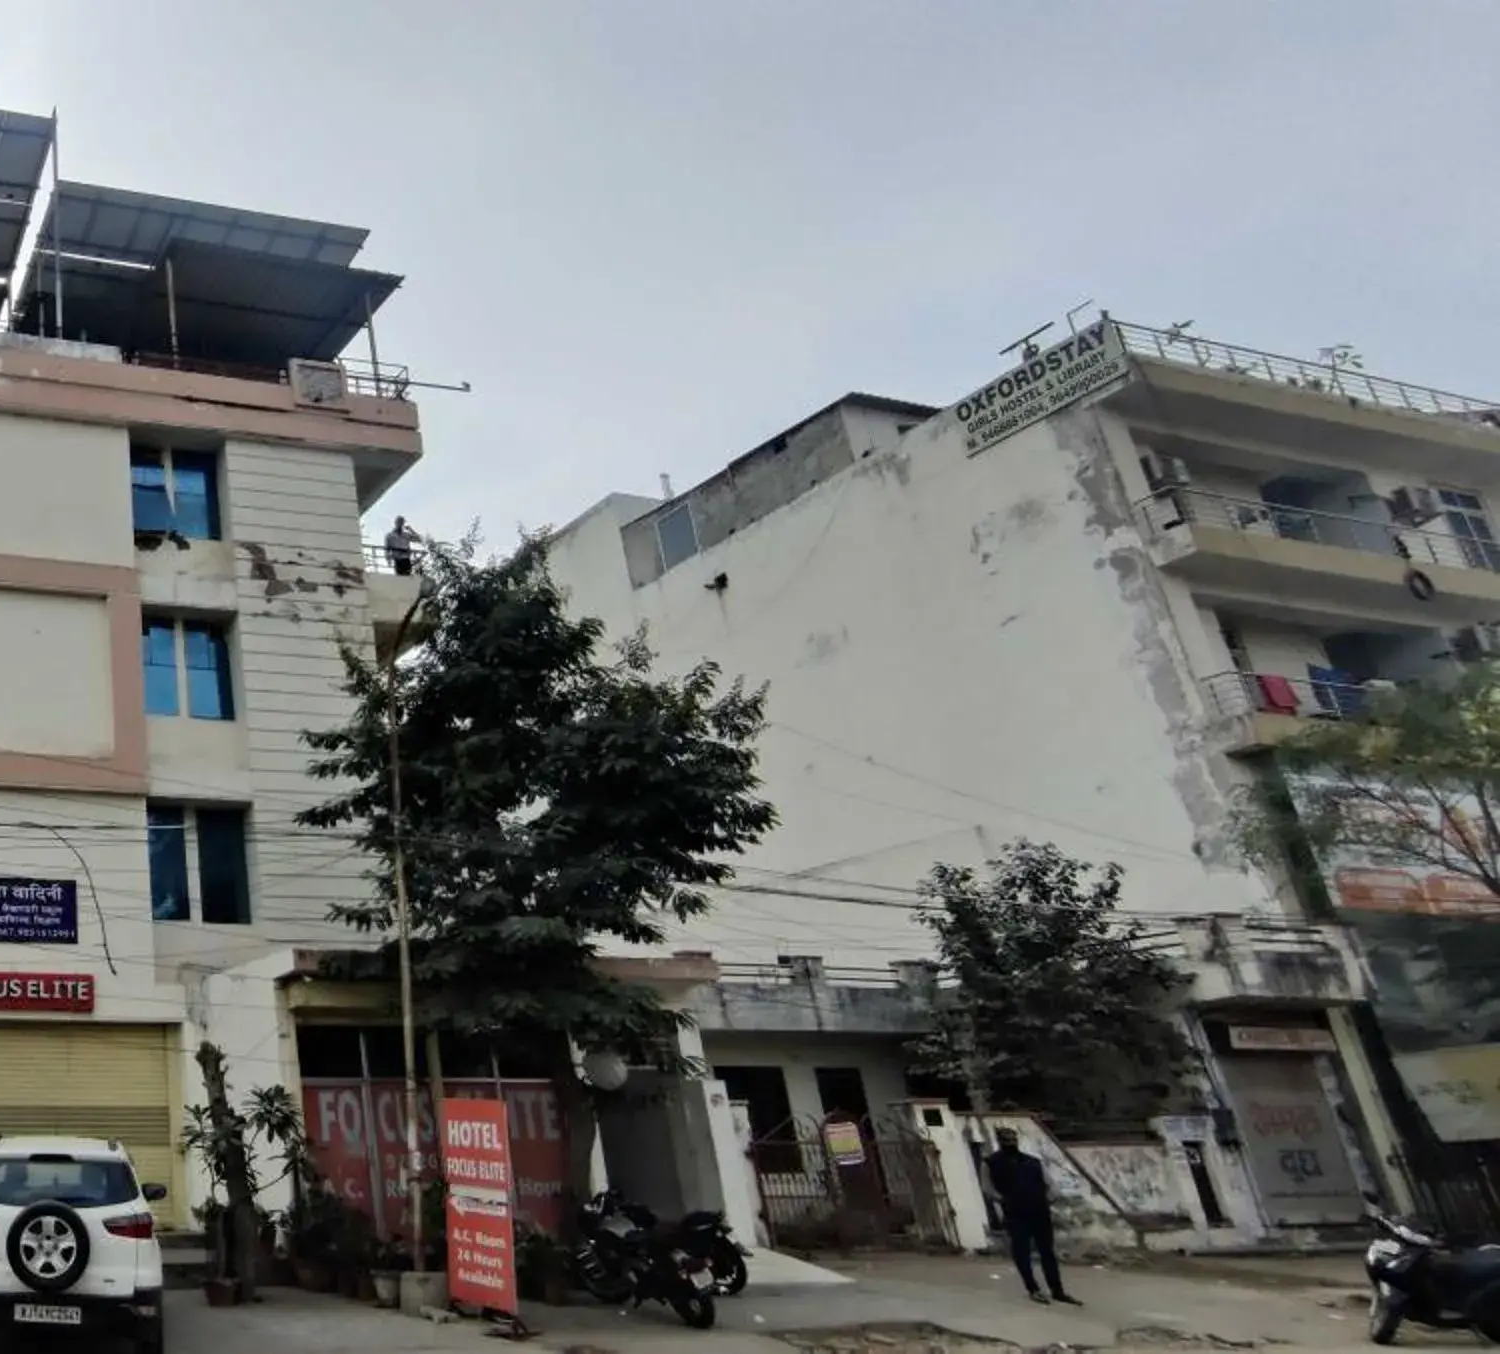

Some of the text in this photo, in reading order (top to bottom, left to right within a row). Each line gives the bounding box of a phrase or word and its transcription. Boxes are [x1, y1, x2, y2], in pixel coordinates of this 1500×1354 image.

[967, 408, 998, 433] GIRLS
[1000, 387, 1043, 416] HOSTEL
[1057, 351, 1105, 384] LIBRARY
[27, 979, 89, 1000] ELITE
[447, 1119, 502, 1150] HOTEL
[447, 1158, 477, 1177] FOCUS
[479, 1161, 506, 1181] ELITE
[473, 1252, 503, 1269] Hours
[458, 1266, 504, 1289] Available
